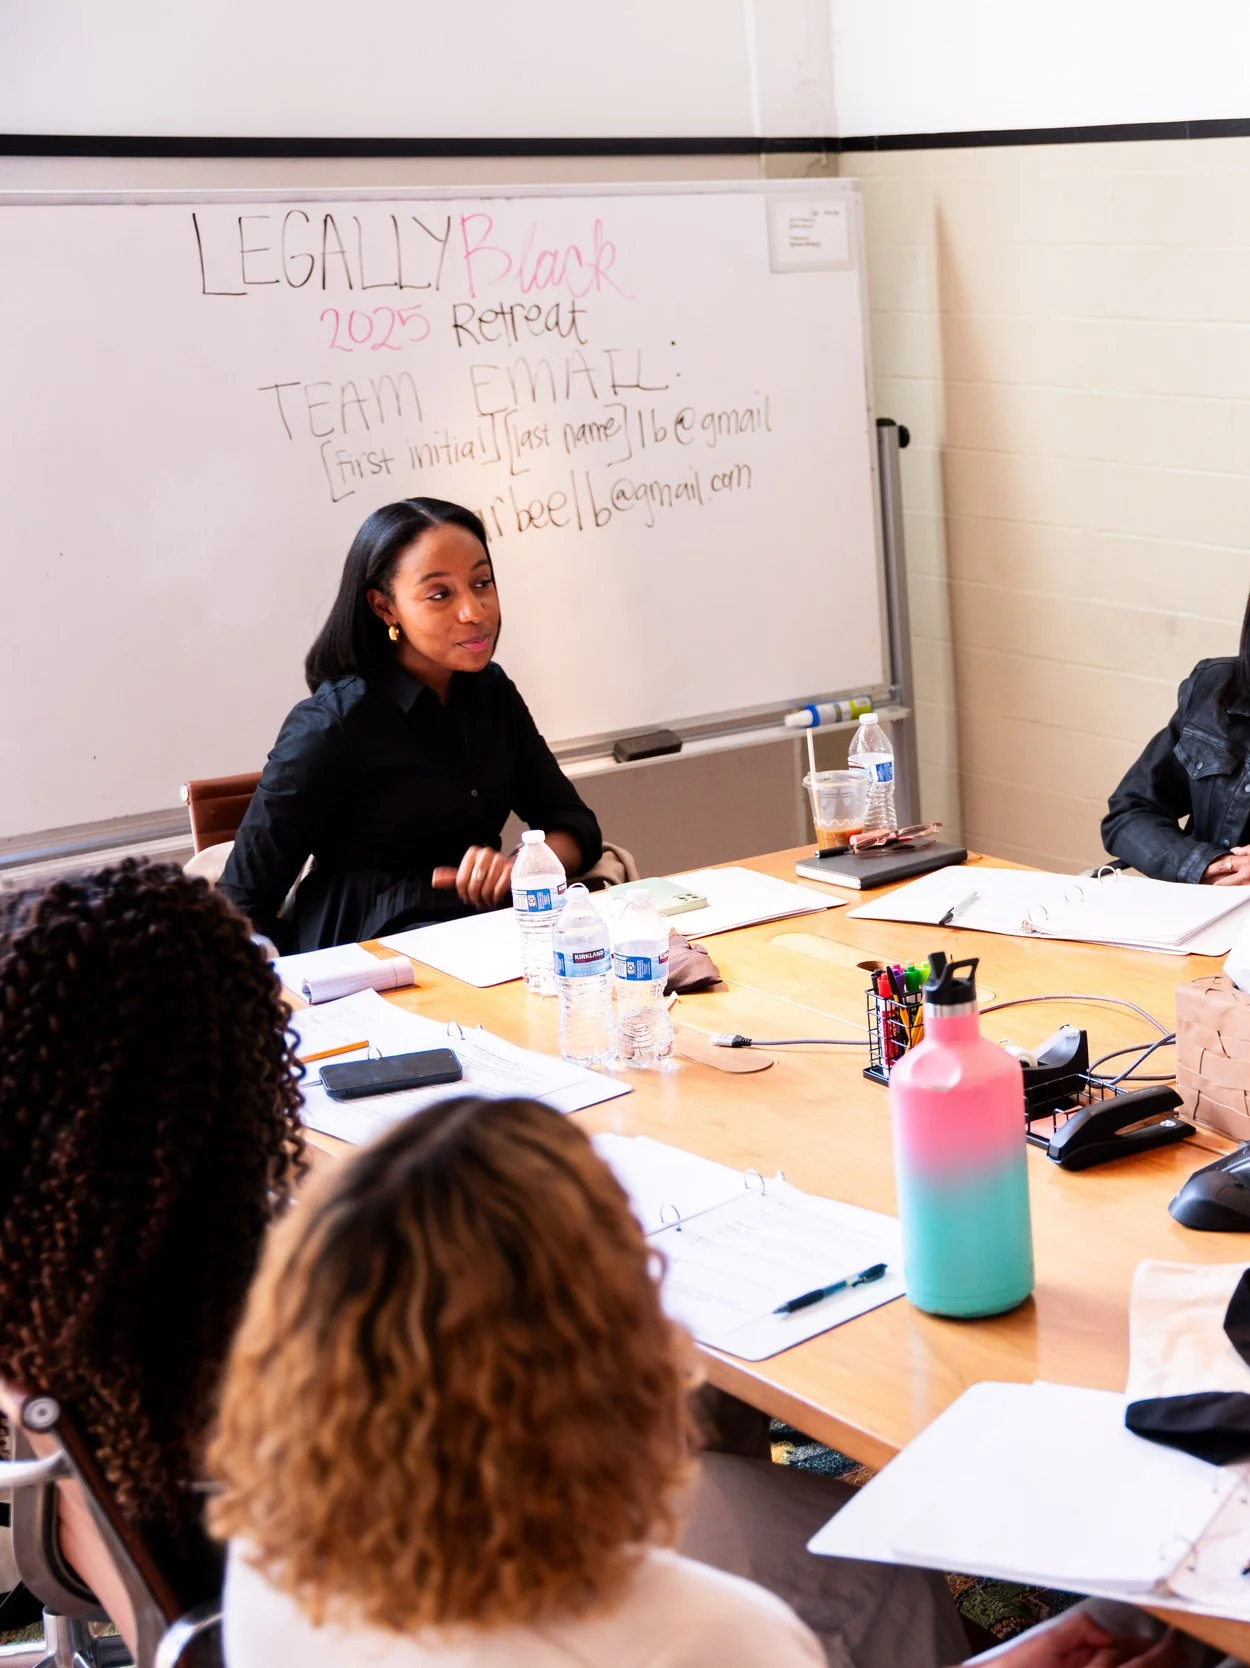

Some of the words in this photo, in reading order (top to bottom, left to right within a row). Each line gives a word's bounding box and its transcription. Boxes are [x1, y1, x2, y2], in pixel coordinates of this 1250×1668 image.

[192, 208, 451, 296] LEGALLY
[460, 212, 636, 299] Black
[319, 304, 431, 352] 2025
[451, 298, 589, 348] Retreat
[257, 371, 424, 441] TEAM
